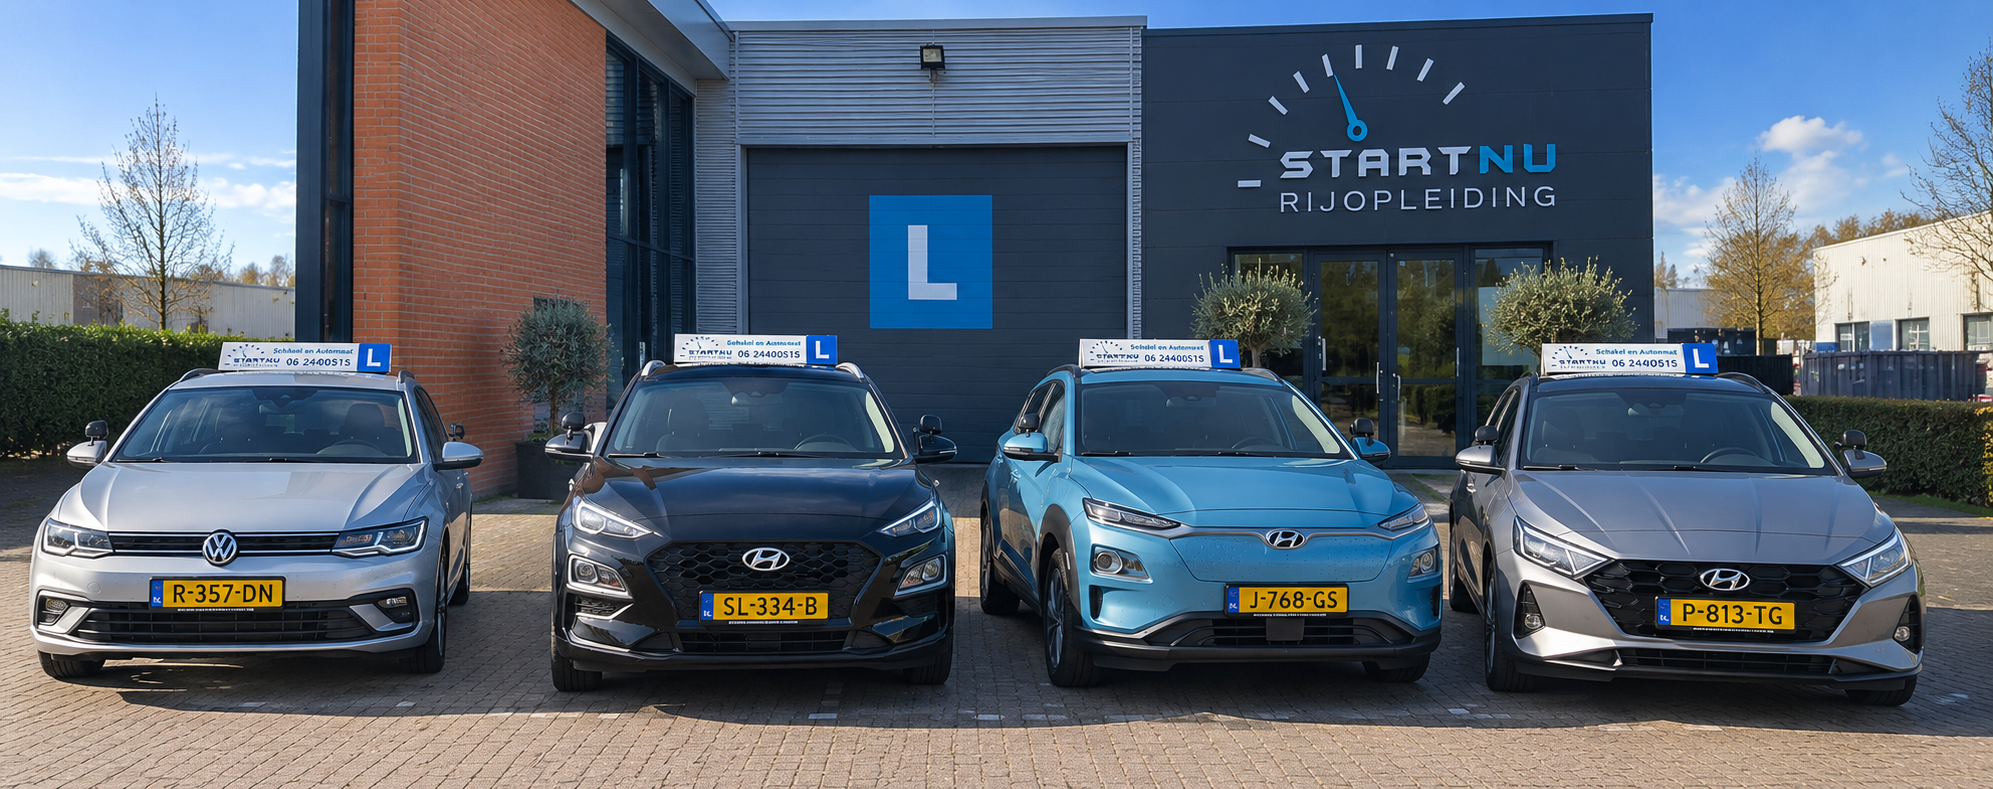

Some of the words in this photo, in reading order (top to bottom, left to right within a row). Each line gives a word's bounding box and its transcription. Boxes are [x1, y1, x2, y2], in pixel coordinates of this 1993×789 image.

[1279, 143, 1556, 178] STARTNU
[1280, 186, 1556, 213] RIJOPLEIDING
[907, 225, 957, 300] L
[366, 348, 381, 367] L
[737, 350, 750, 358] 06
[815, 341, 830, 359] L
[1144, 354, 1156, 362] 06
[1218, 344, 1233, 364] L
[1693, 348, 1710, 369] L
[286, 358, 299, 366] 06
[1612, 359, 1625, 367] 06
[173, 584, 273, 603] R-357-DN
[1249, 591, 1338, 609] J-768-GS
[723, 597, 818, 616] SL-334-B
[1682, 603, 1783, 625] P-813-TG
